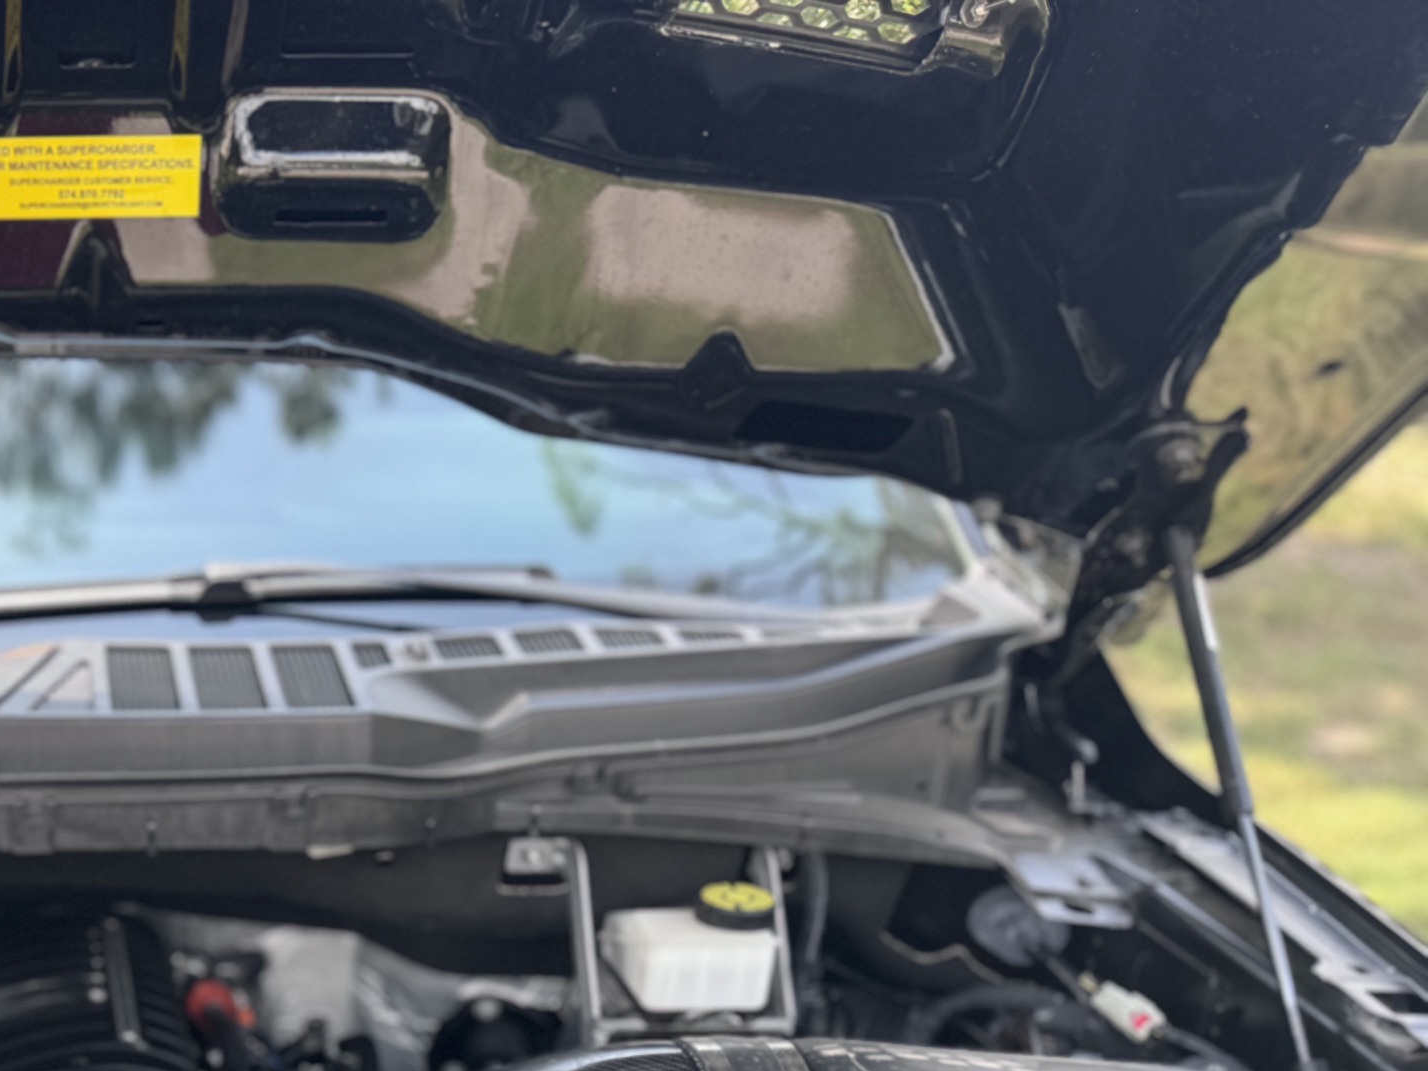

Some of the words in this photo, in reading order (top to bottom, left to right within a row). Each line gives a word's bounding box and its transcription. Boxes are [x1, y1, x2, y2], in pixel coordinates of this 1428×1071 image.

[13, 146, 42, 156] WITH
[9, 160, 92, 171] MAINTENANCE
[10, 177, 80, 185] SUPERCHARGER
